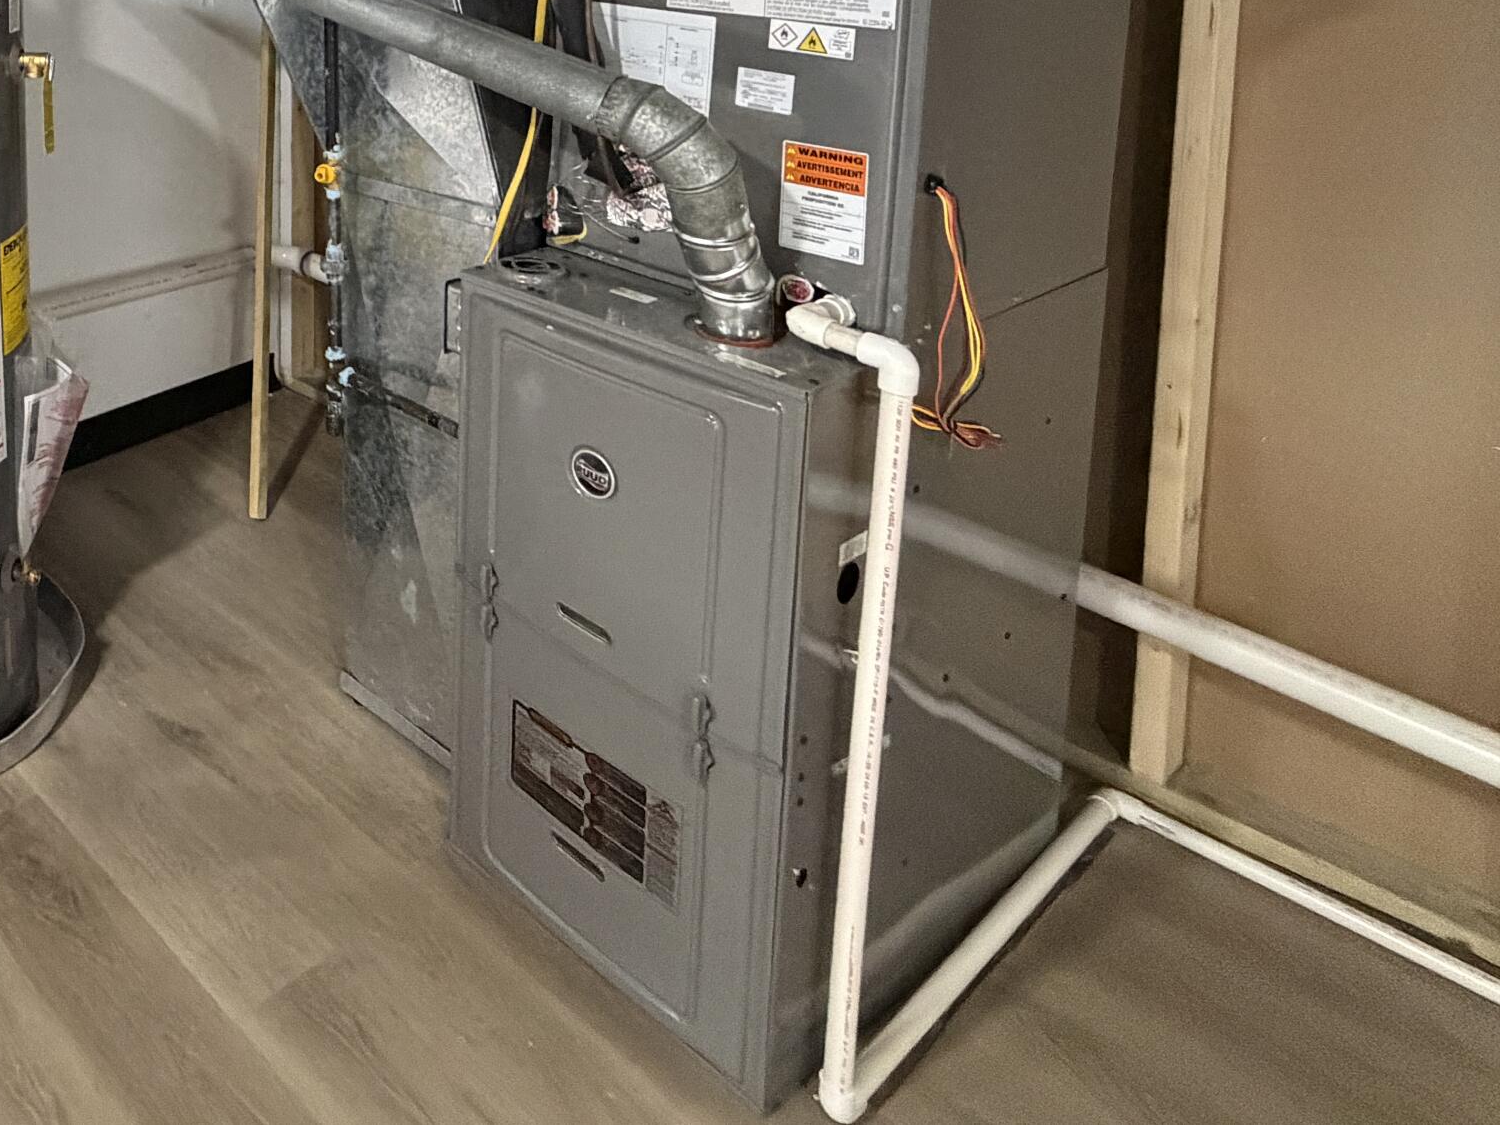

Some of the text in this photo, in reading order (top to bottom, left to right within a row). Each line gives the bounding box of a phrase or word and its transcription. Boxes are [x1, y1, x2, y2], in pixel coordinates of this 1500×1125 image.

[798, 147, 864, 166] WARNING
[796, 160, 864, 179] AVERTISSEMENT
[800, 174, 860, 192] ADVERTENCIA
